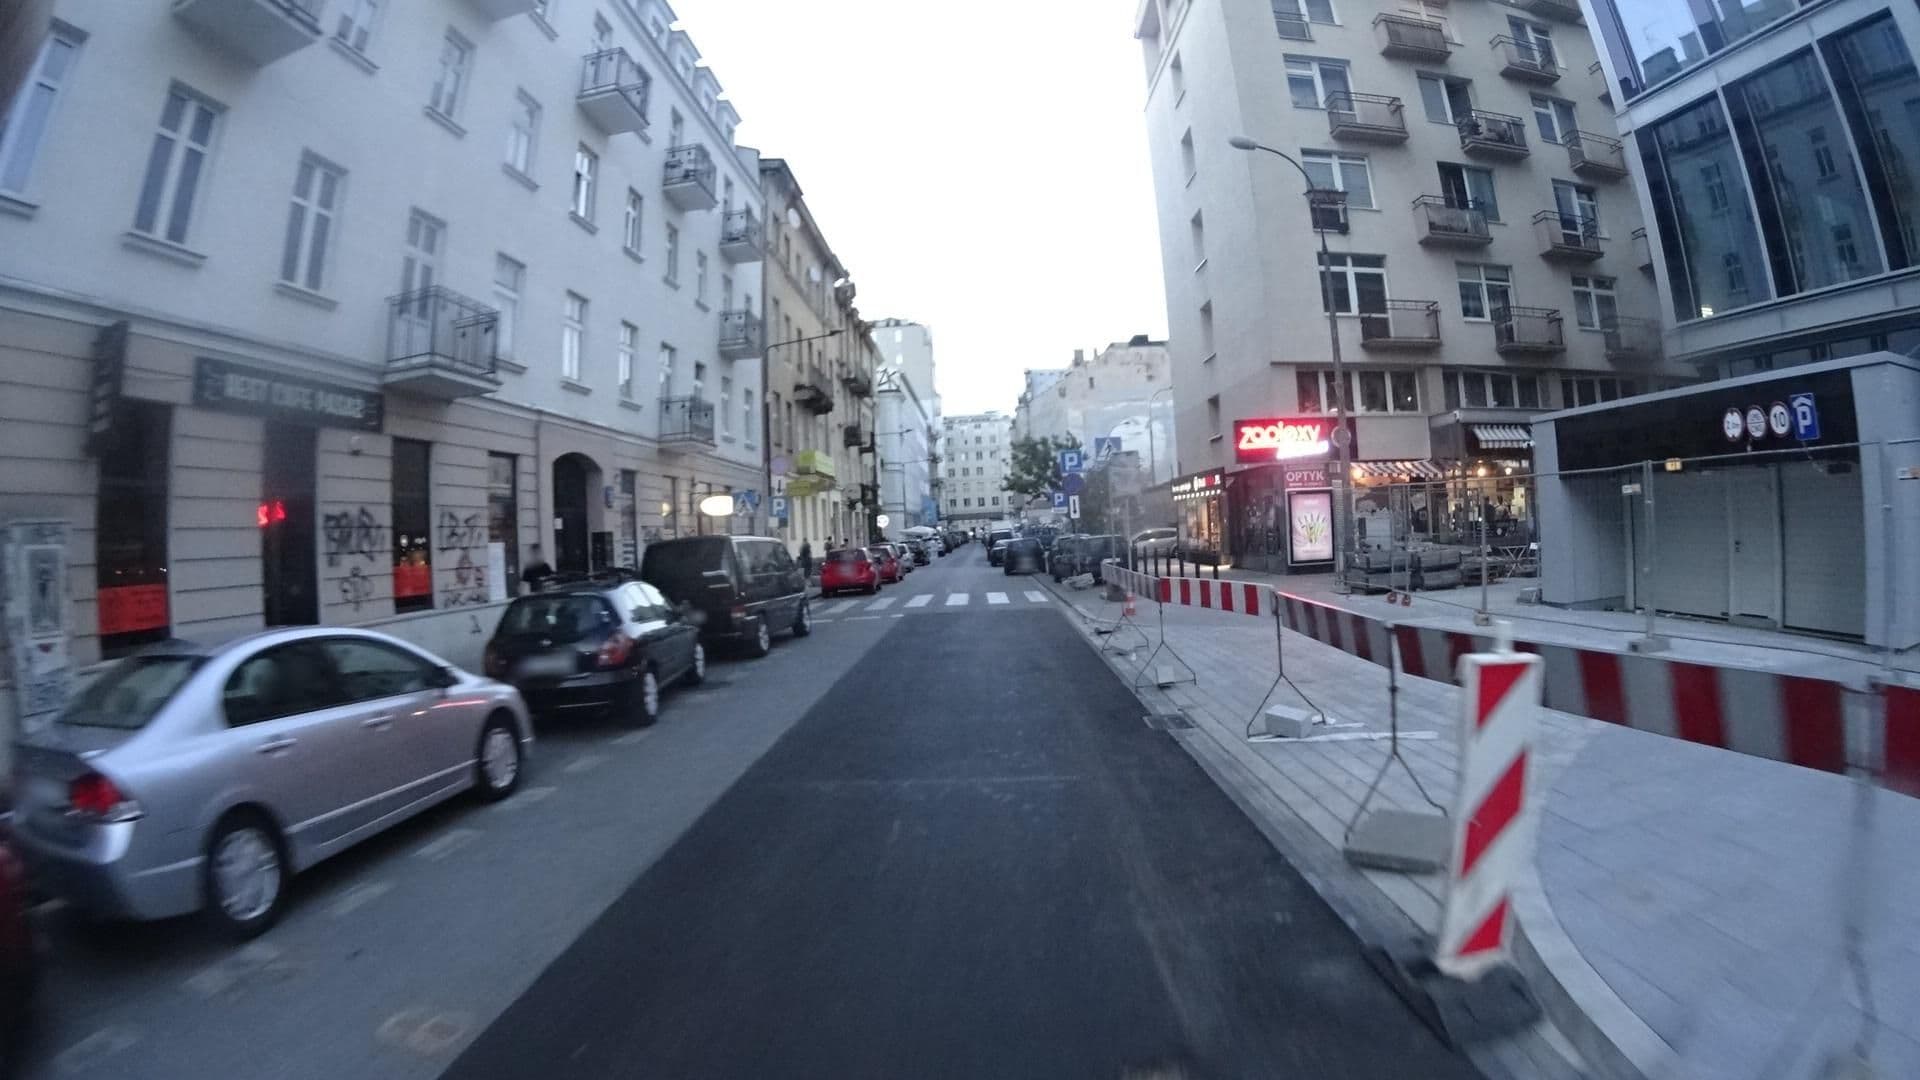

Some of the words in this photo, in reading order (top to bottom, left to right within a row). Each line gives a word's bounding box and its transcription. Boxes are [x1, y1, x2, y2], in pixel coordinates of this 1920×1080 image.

[1774, 411, 1786, 427] 10
[1798, 406, 1812, 434] P
[1286, 471, 1325, 481] OPTYK
[772, 499, 785, 515] P
